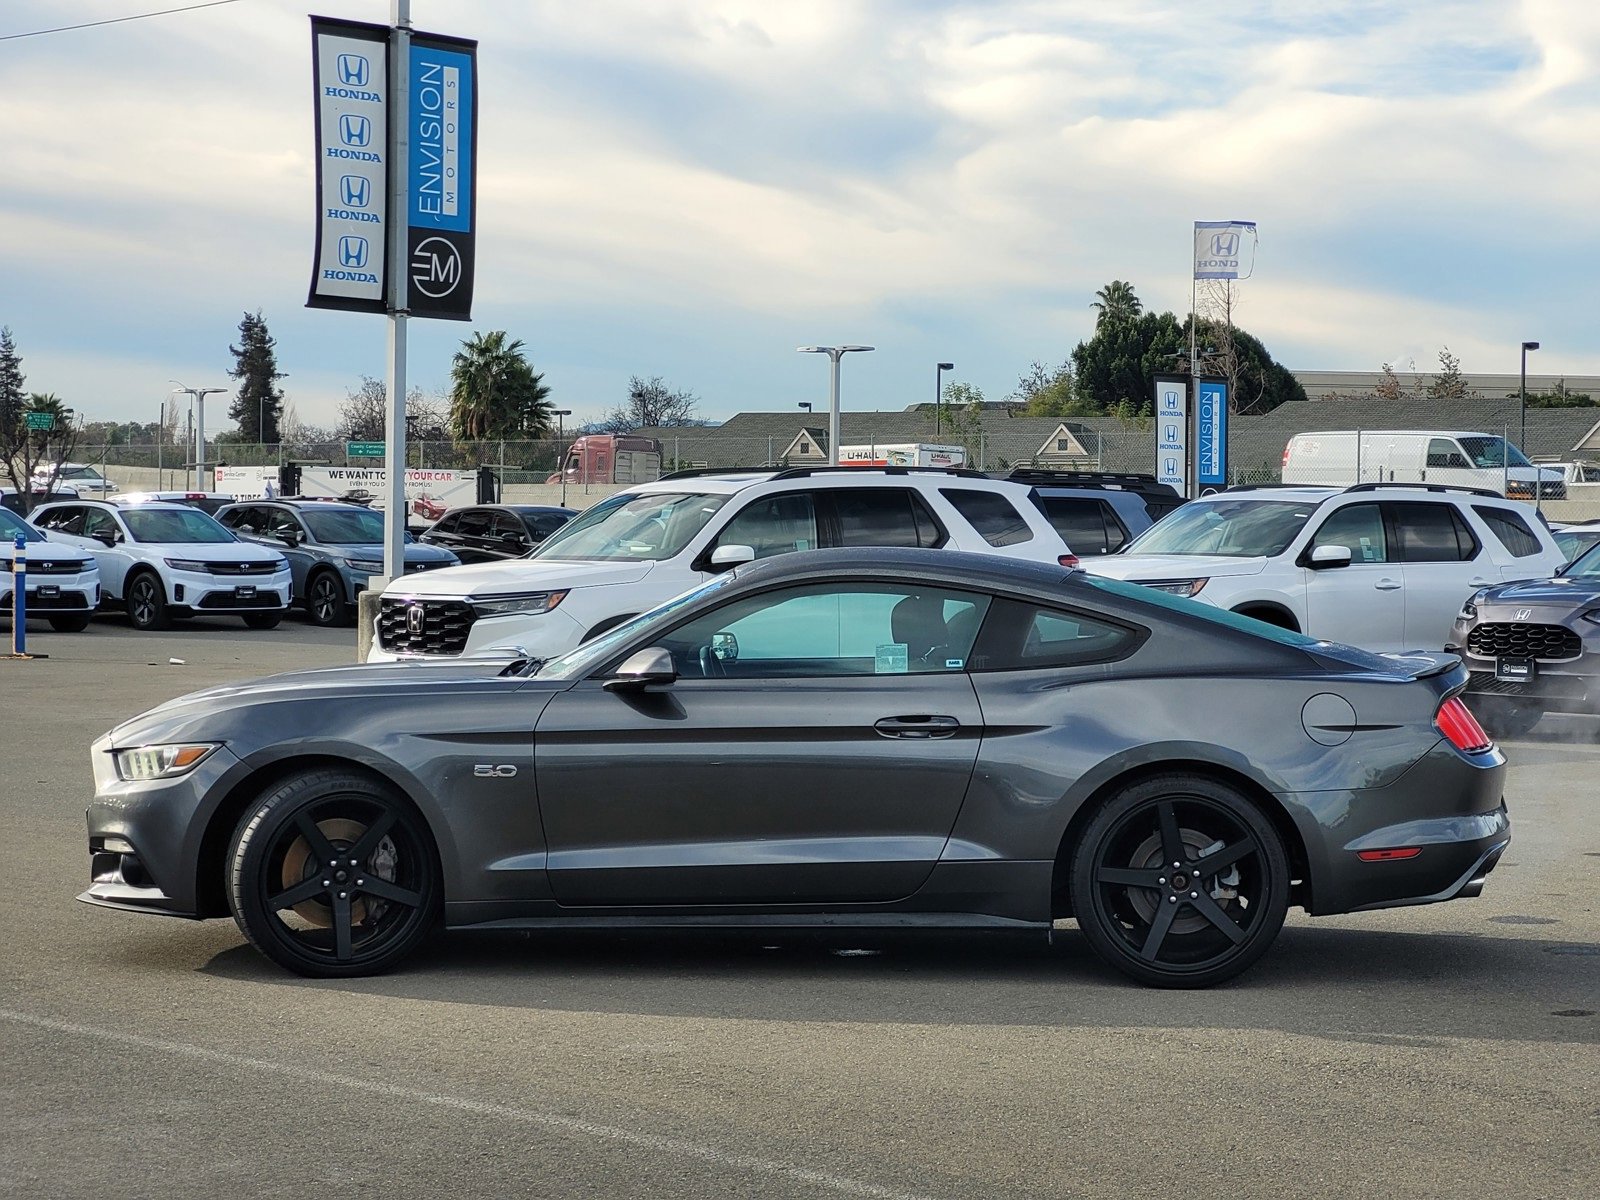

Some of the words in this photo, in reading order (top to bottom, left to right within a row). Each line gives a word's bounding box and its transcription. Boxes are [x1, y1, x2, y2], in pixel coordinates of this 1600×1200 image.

[325, 86, 382, 103] HONDA
[418, 62, 441, 214] ENVISION
[446, 80, 456, 204] MOTORS
[327, 147, 382, 163] HONDA
[327, 208, 381, 224] HONDA
[1197, 260, 1239, 268] HOND
[323, 269, 379, 284] HONDA
[1159, 410, 1184, 418] HONDA
[1201, 391, 1213, 476] ENVISION
[1159, 443, 1184, 451] HONDA
[847, 452, 880, 460] U-HAUL
[328, 470, 344, 479] WE
[345, 471, 374, 480] WANT
[408, 472, 433, 481] YOUR
[434, 473, 452, 482] CAR
[473, 764, 518, 777] 5.0
